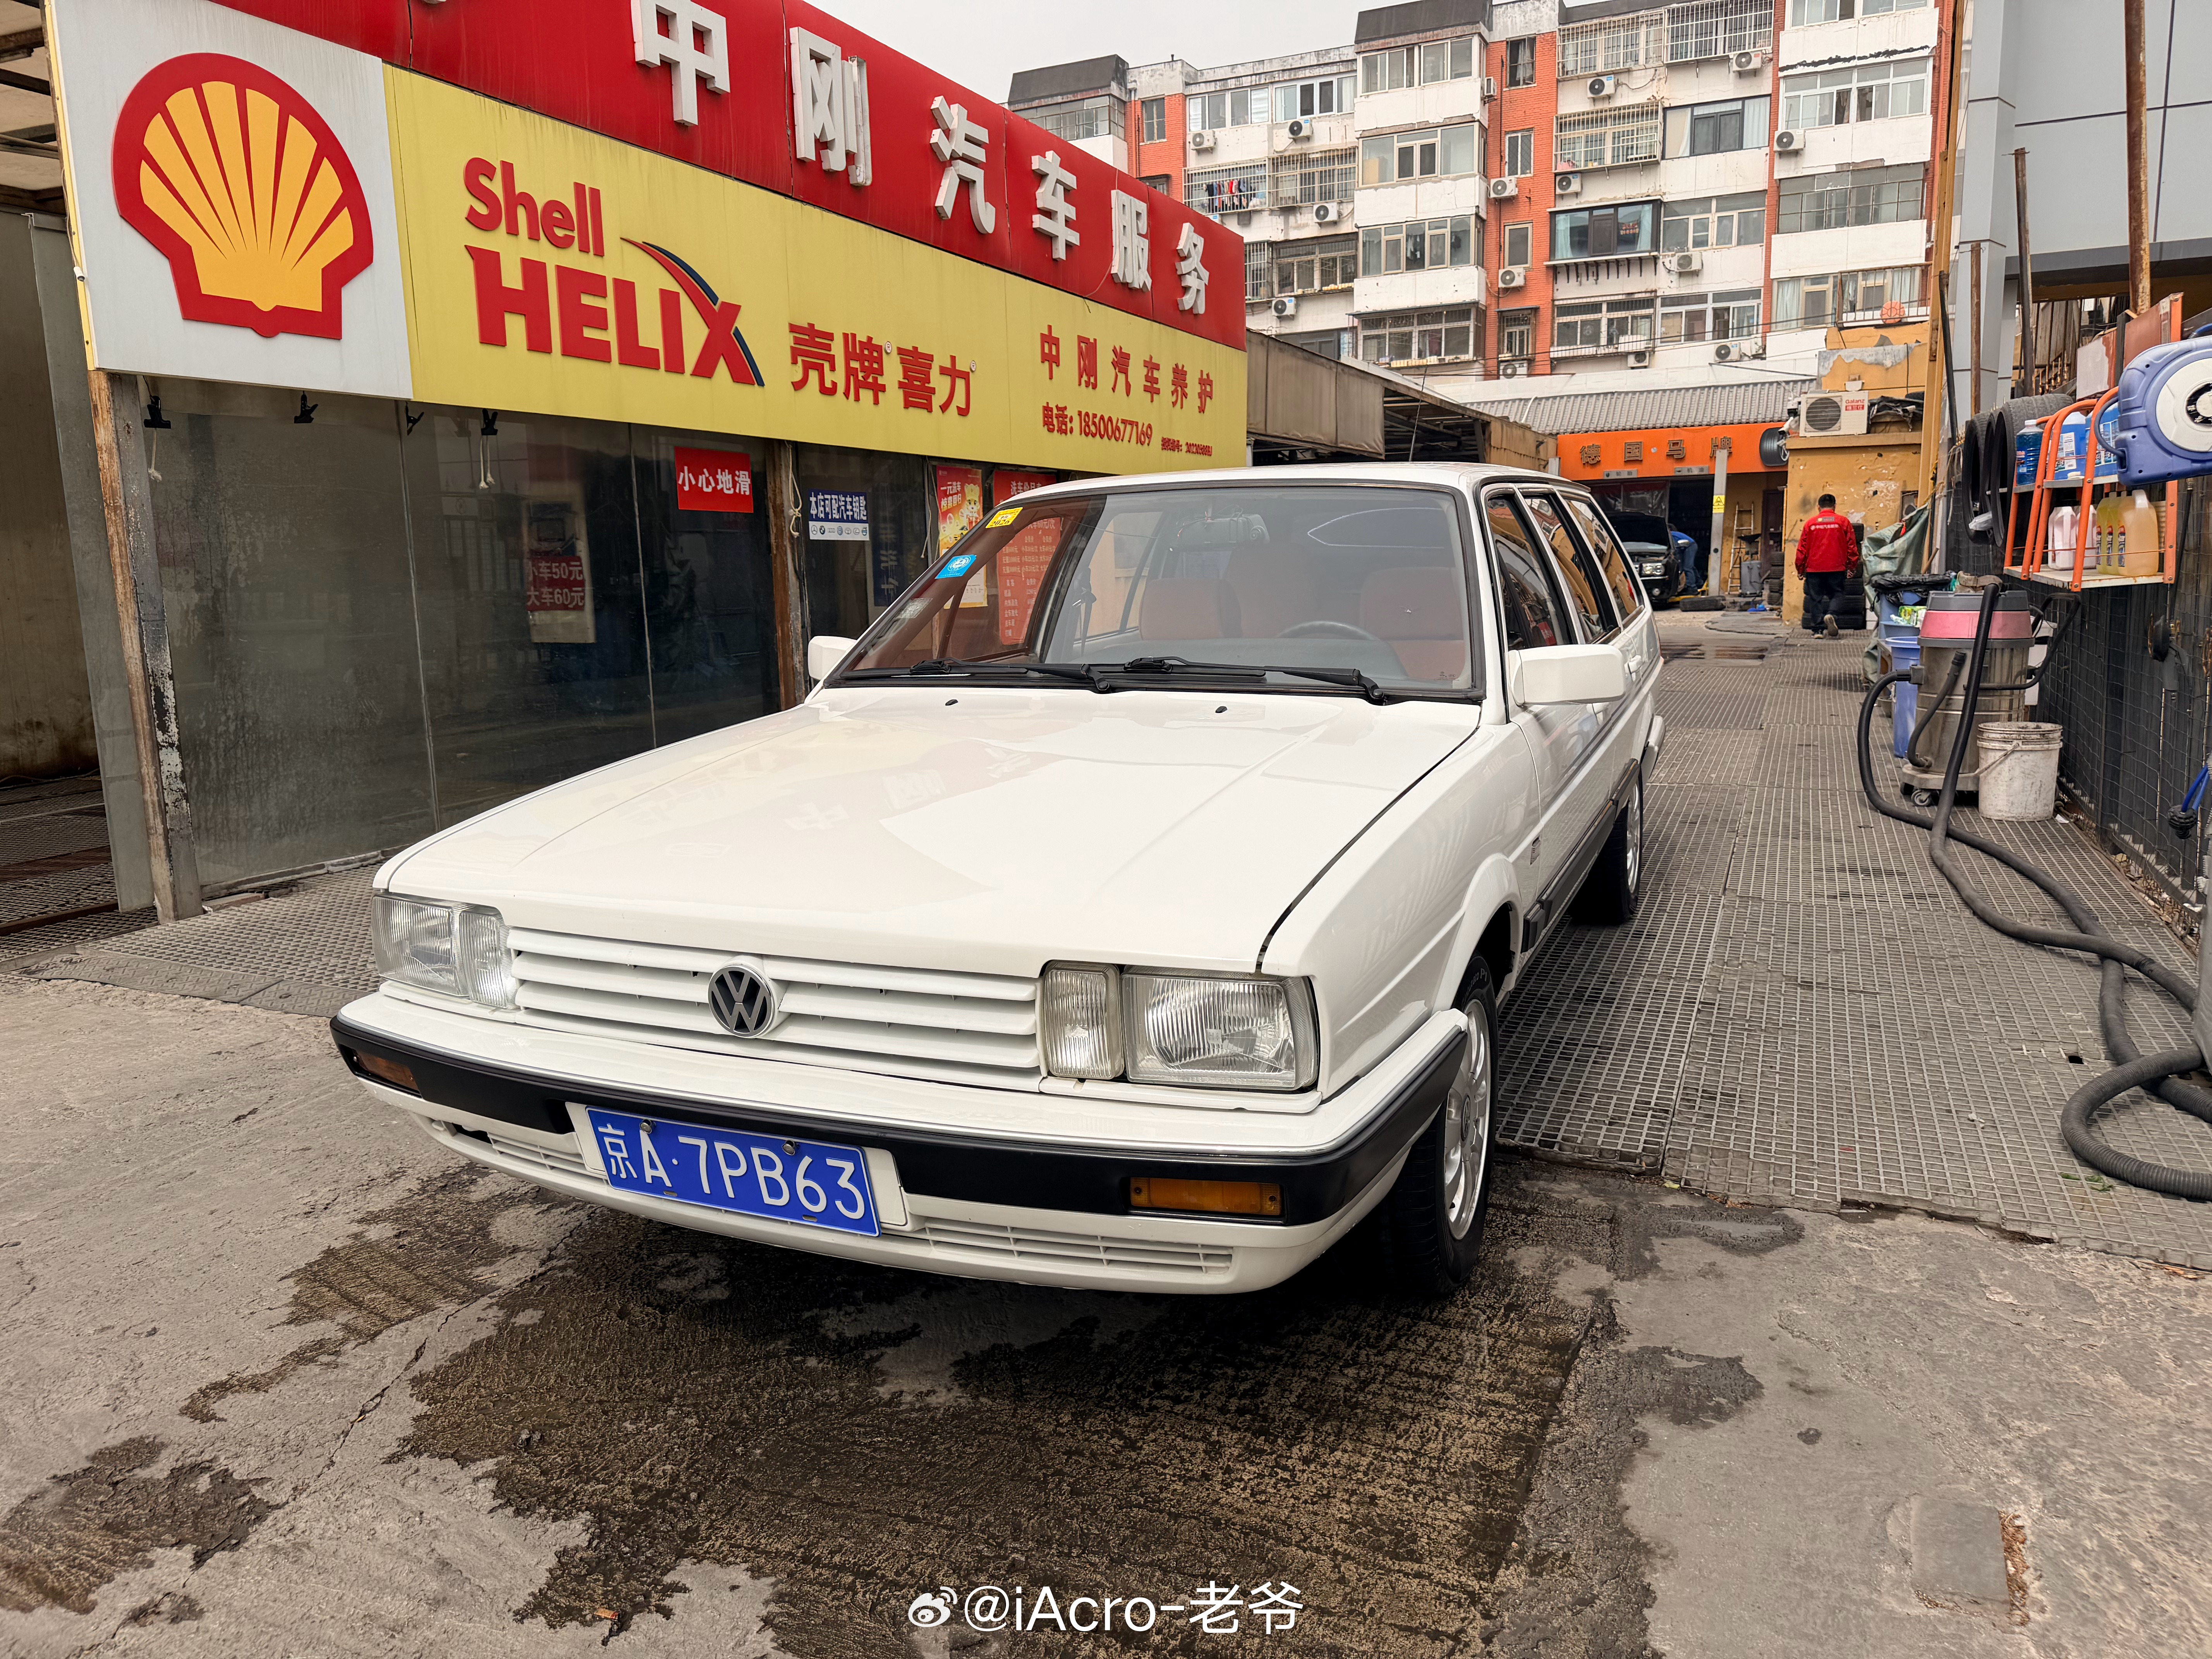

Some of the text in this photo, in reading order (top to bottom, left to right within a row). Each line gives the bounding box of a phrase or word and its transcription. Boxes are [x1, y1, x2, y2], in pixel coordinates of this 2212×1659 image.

[464, 157, 605, 257] Shell
[464, 238, 754, 386] HELIX
[1040, 325, 1213, 414] 中刚汽车养护
[1580, 436, 1733, 465] 德国马牌
[678, 466, 751, 496] 小心地滑
[809, 492, 867, 520] 本店可配汽车钥匙
[526, 586, 584, 608] 大车60元
